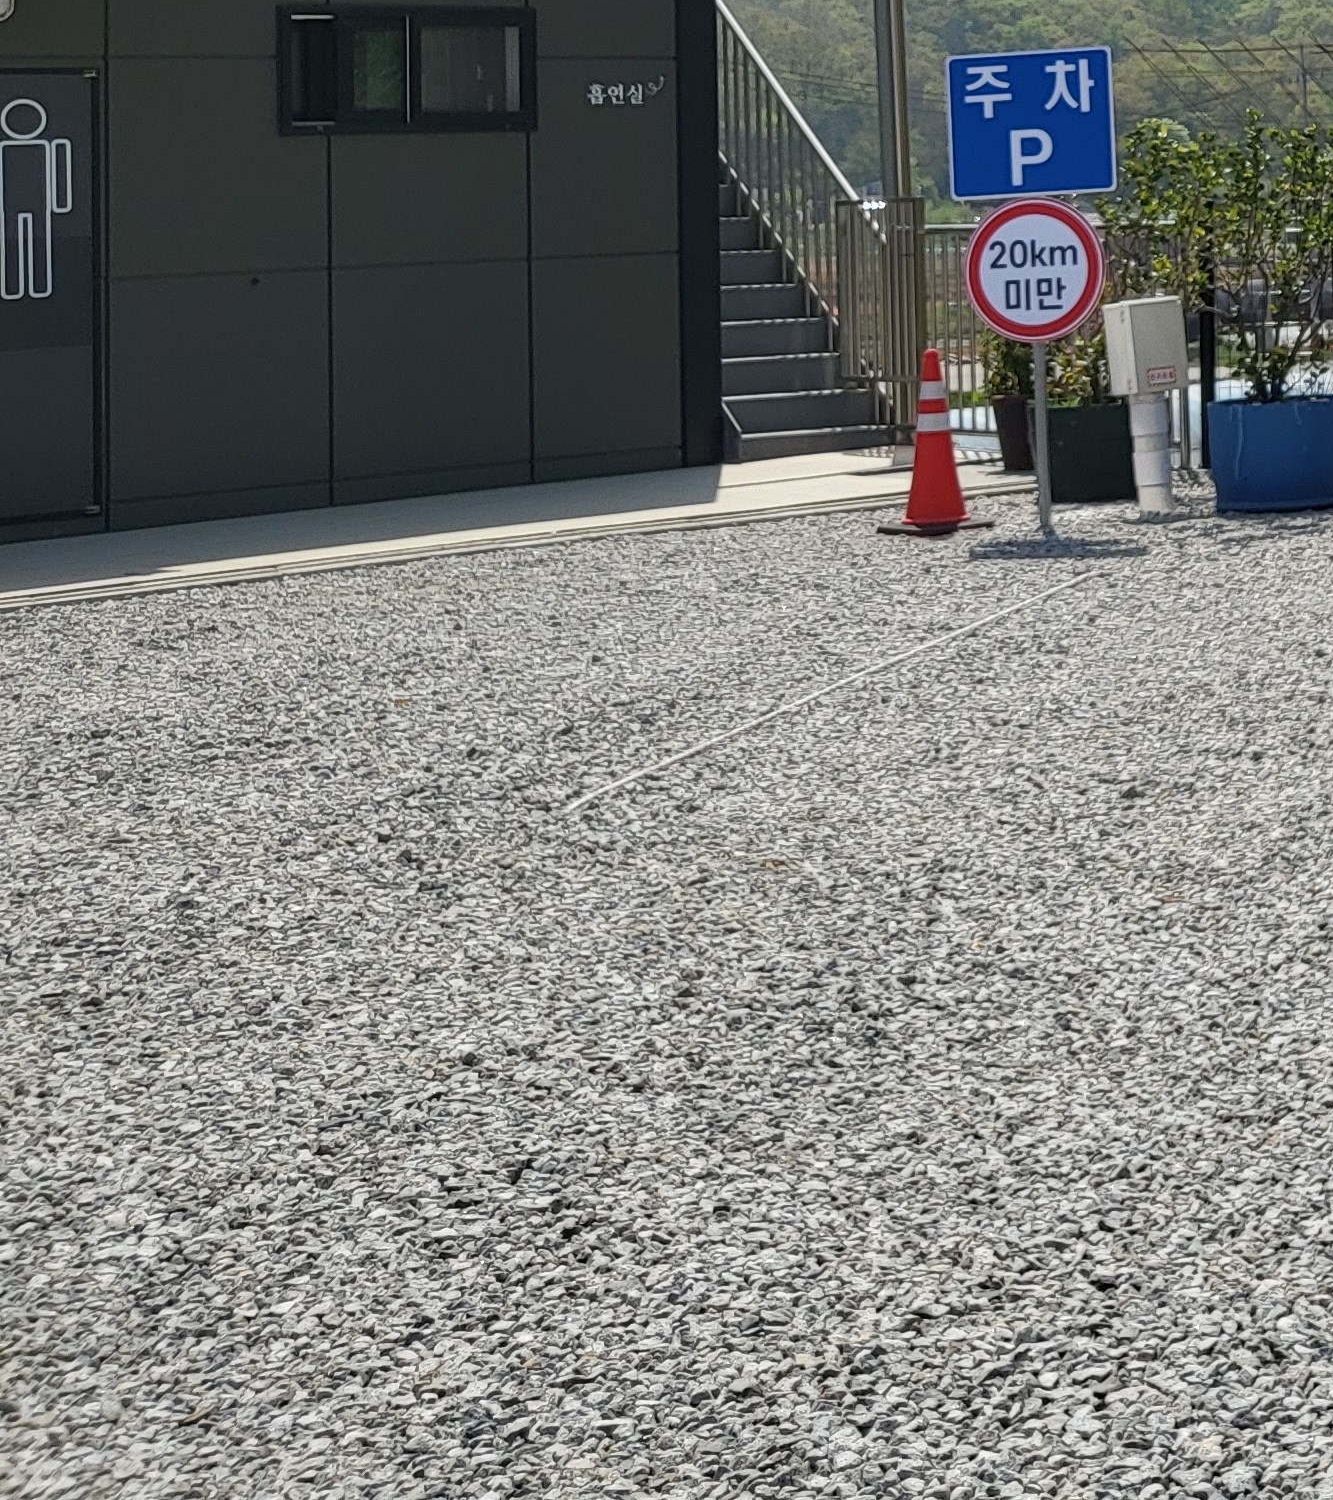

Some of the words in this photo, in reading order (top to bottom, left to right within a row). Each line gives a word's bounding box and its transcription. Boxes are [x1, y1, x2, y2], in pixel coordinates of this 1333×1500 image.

[586, 83, 644, 105] 흡연실
[1009, 128, 1053, 186] P
[989, 239, 1078, 269] 20km
[1004, 277, 1067, 311] 미만
